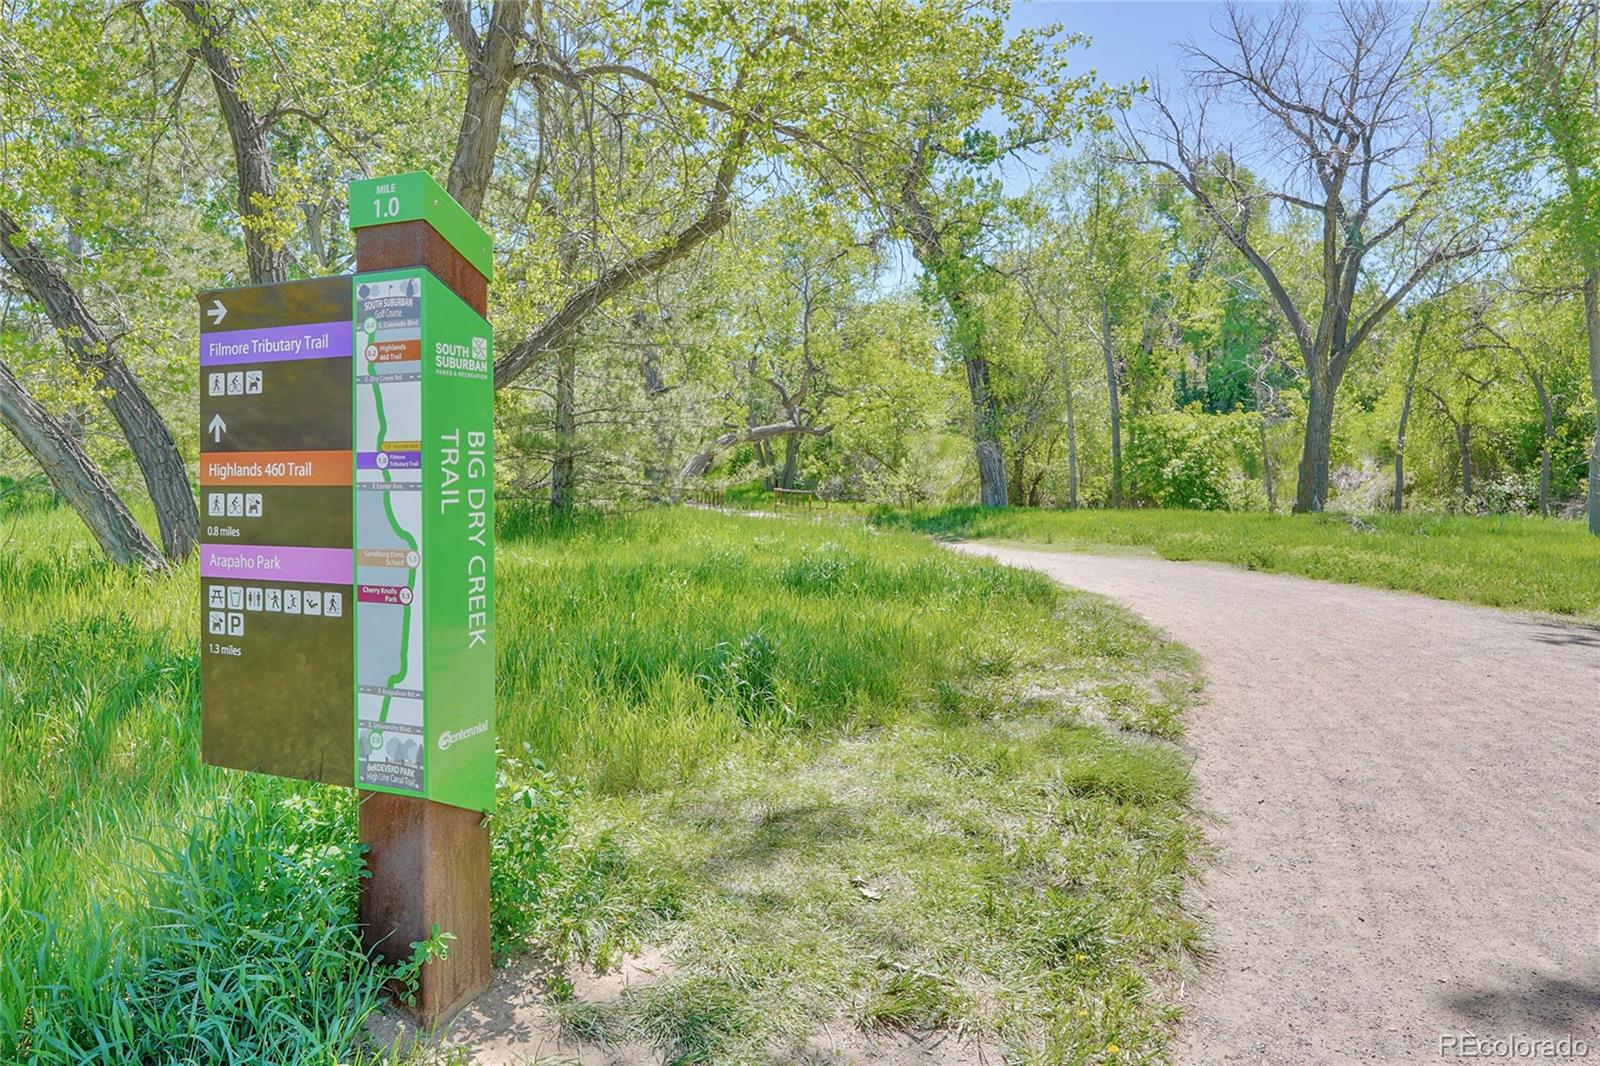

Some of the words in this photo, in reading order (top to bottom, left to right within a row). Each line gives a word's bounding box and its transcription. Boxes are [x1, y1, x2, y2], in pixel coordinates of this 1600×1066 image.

[376, 183, 396, 195] MILE
[373, 197, 400, 218] 1.0
[364, 300, 382, 311] SOUTH
[384, 298, 413, 308] SUBURBAN
[374, 309, 385, 318] Golf
[386, 308, 402, 317] Course
[384, 320, 406, 328] Colorado
[209, 342, 249, 357] Filmore
[251, 336, 301, 354] Tributary
[304, 334, 329, 350] Trail
[380, 344, 406, 353] Highlands
[435, 342, 469, 358] SOUTH
[390, 352, 402, 360] Trail
[435, 355, 488, 373] SUBURBAN
[370, 375, 379, 383] Dry
[435, 369, 453, 377] PARKS
[458, 371, 488, 380] RECREATION
[467, 431, 485, 478] BIG
[208, 463, 262, 480] Highlands
[264, 462, 286, 477] 460
[288, 462, 312, 477] Trail
[441, 428, 460, 514] TRAIL
[468, 488, 486, 546] DRY
[207, 526, 219, 537] 0.8
[220, 526, 241, 537] miles
[364, 550, 389, 559] Sandburg
[209, 553, 254, 571] Arapaho
[256, 555, 281, 570] Park
[362, 586, 380, 595] Cherry
[381, 587, 398, 595] Knolls
[468, 555, 486, 649] CREEK
[230, 615, 241, 633] P
[209, 643, 220, 654] 1.3
[221, 644, 242, 656] miles
[382, 688, 406, 697] Arapahoe
[400, 767, 415, 778] PARK
[366, 772, 379, 782] High
[380, 774, 390, 782] Line
[391, 775, 405, 784] Canal
[405, 777, 416, 787] Trail
